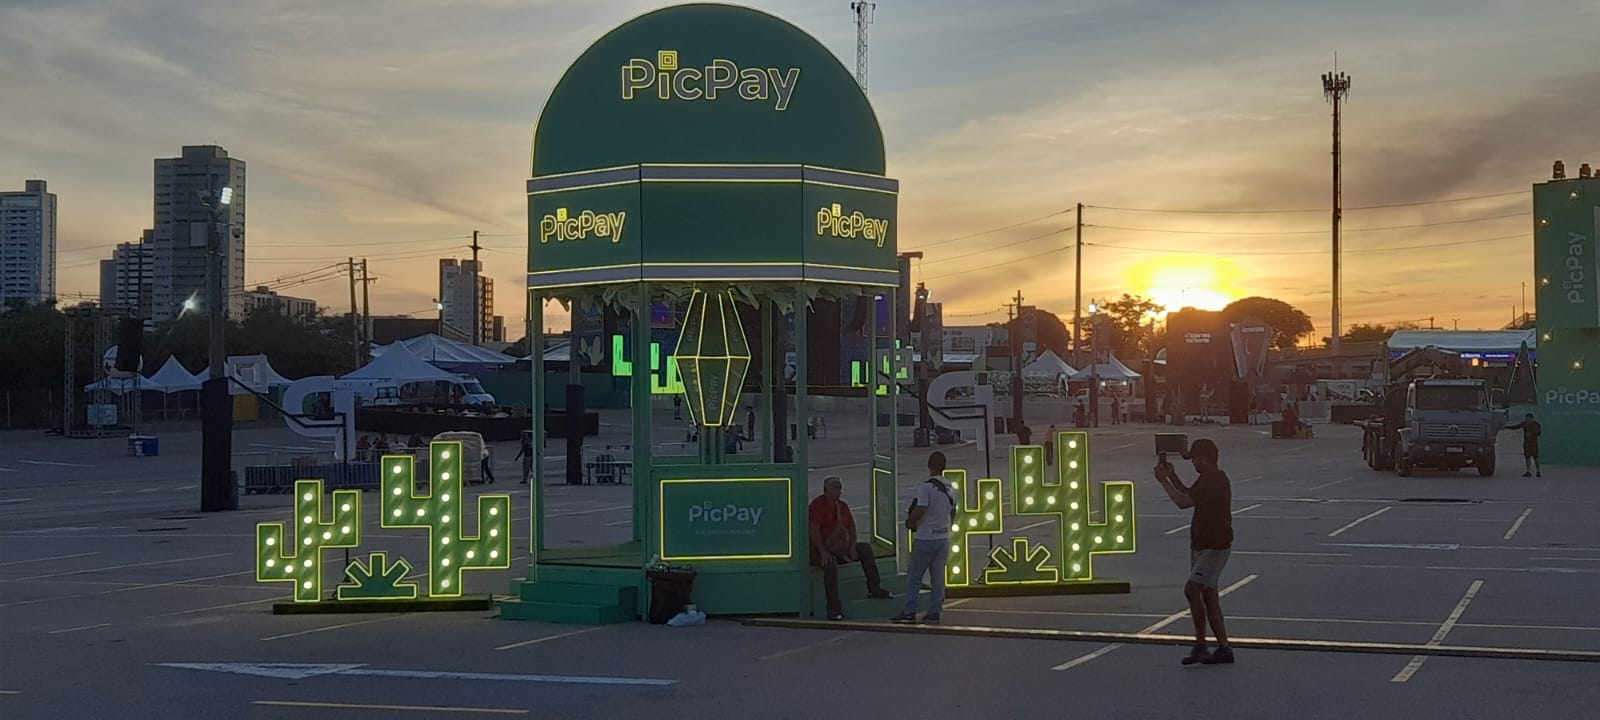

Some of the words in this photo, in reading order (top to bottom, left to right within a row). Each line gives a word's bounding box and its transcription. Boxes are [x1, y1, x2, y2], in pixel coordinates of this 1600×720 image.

[622, 51, 800, 109] PicPay
[540, 208, 625, 243] PicPay
[817, 204, 888, 247] PicPay
[1564, 232, 1586, 304] PicPay
[688, 501, 762, 526] PicPay
